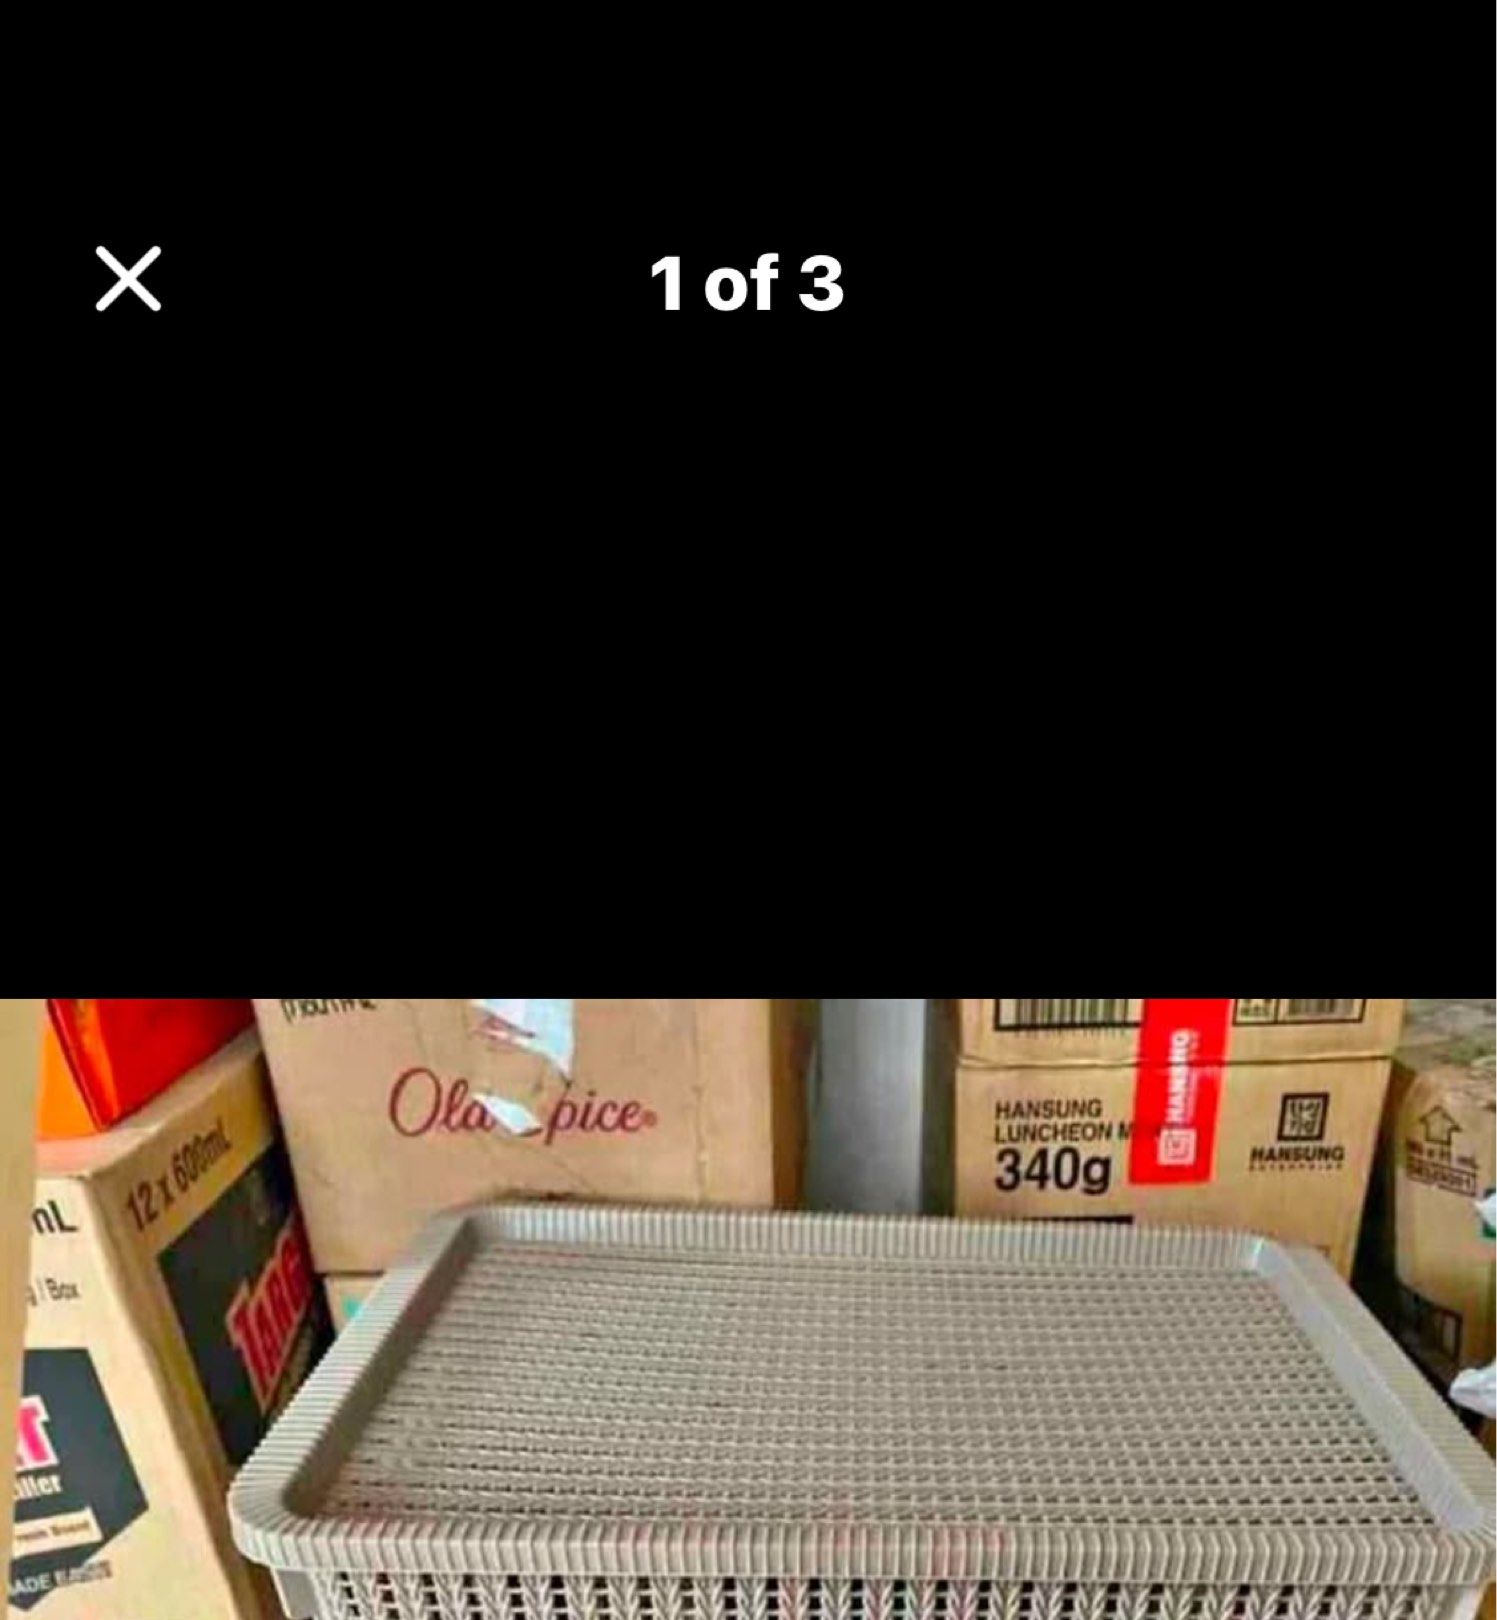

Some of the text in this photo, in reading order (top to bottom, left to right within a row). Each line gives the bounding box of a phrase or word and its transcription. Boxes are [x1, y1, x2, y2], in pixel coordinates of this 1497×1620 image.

[994, 1099, 1102, 1120] HANSUNG
[994, 1120, 1112, 1143] LUNCHEON
[1250, 1146, 1344, 1162] HANSUNG
[127, 1118, 230, 1233] 12 x 600mL
[995, 1146, 1112, 1196] 340g
